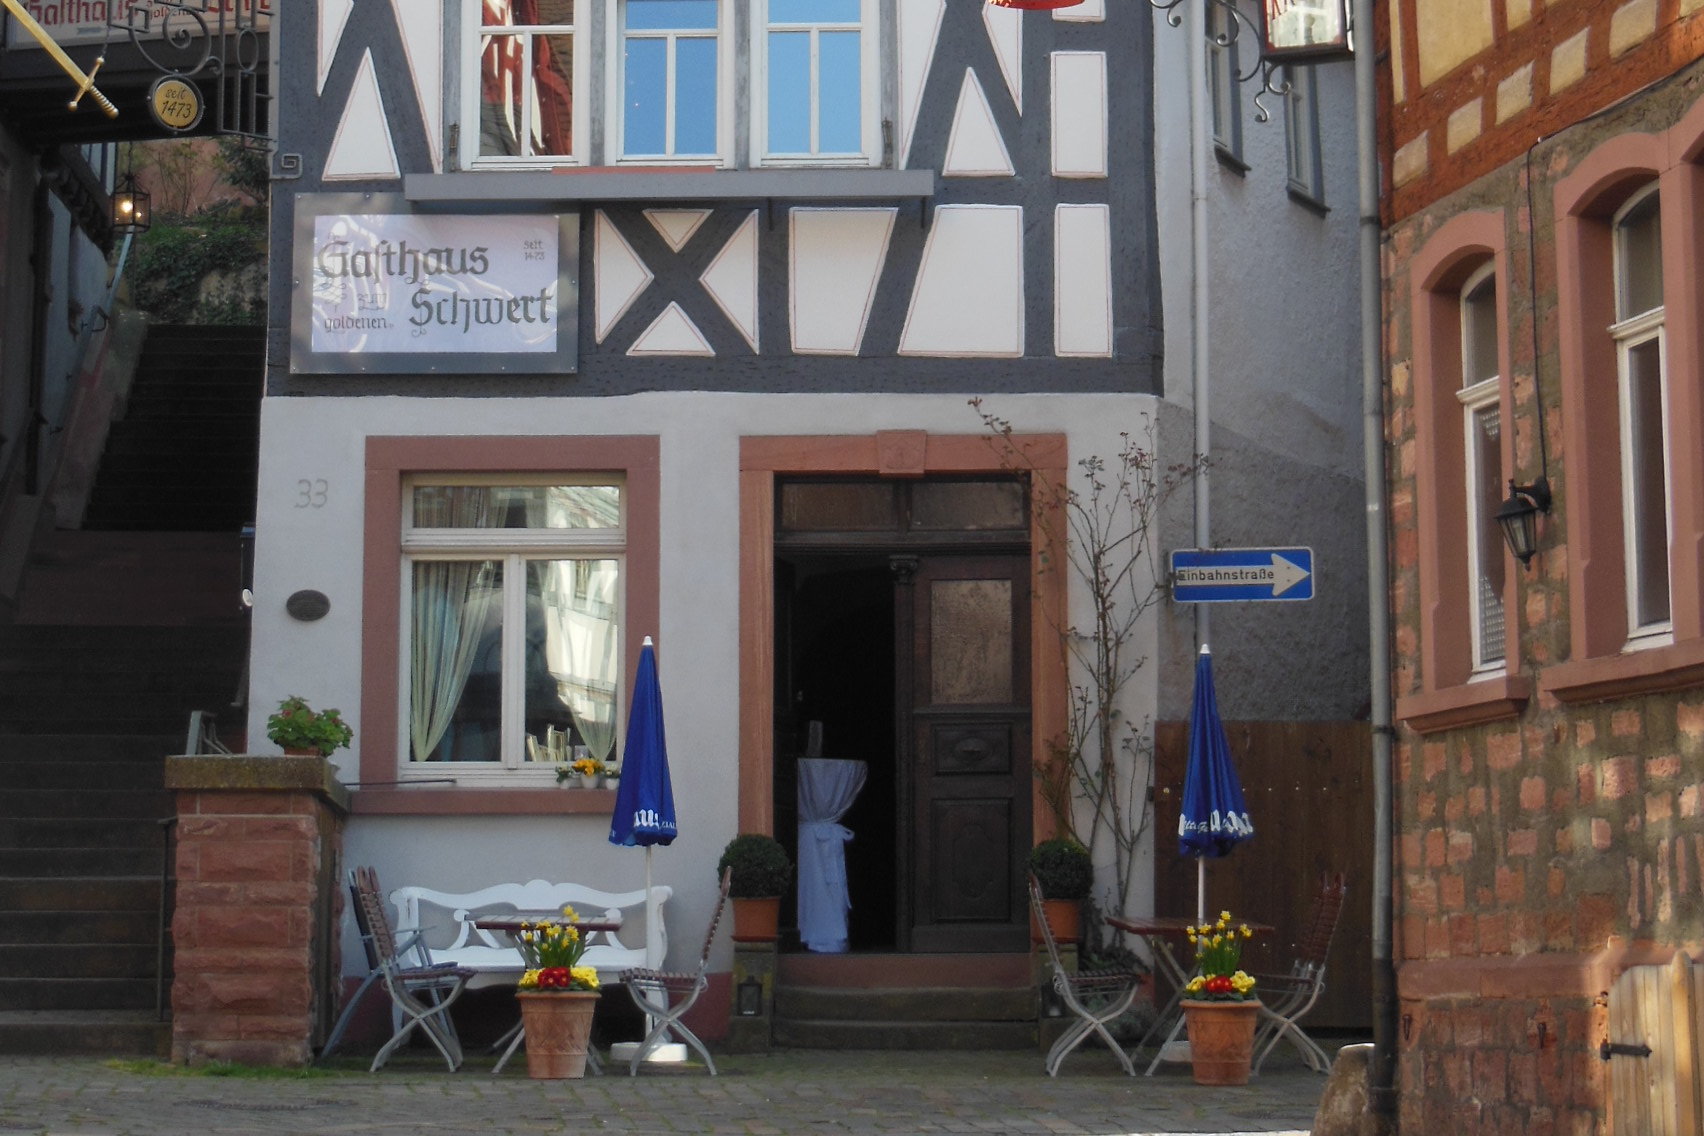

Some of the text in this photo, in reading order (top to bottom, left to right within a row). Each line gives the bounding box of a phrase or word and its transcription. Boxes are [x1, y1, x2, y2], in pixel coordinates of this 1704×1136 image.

[162, 100, 192, 119] 1473
[408, 287, 554, 334] Schwert
[324, 315, 388, 333] goldenen
[294, 478, 329, 509] 33
[1177, 568, 1275, 582] Einbahnstraße
